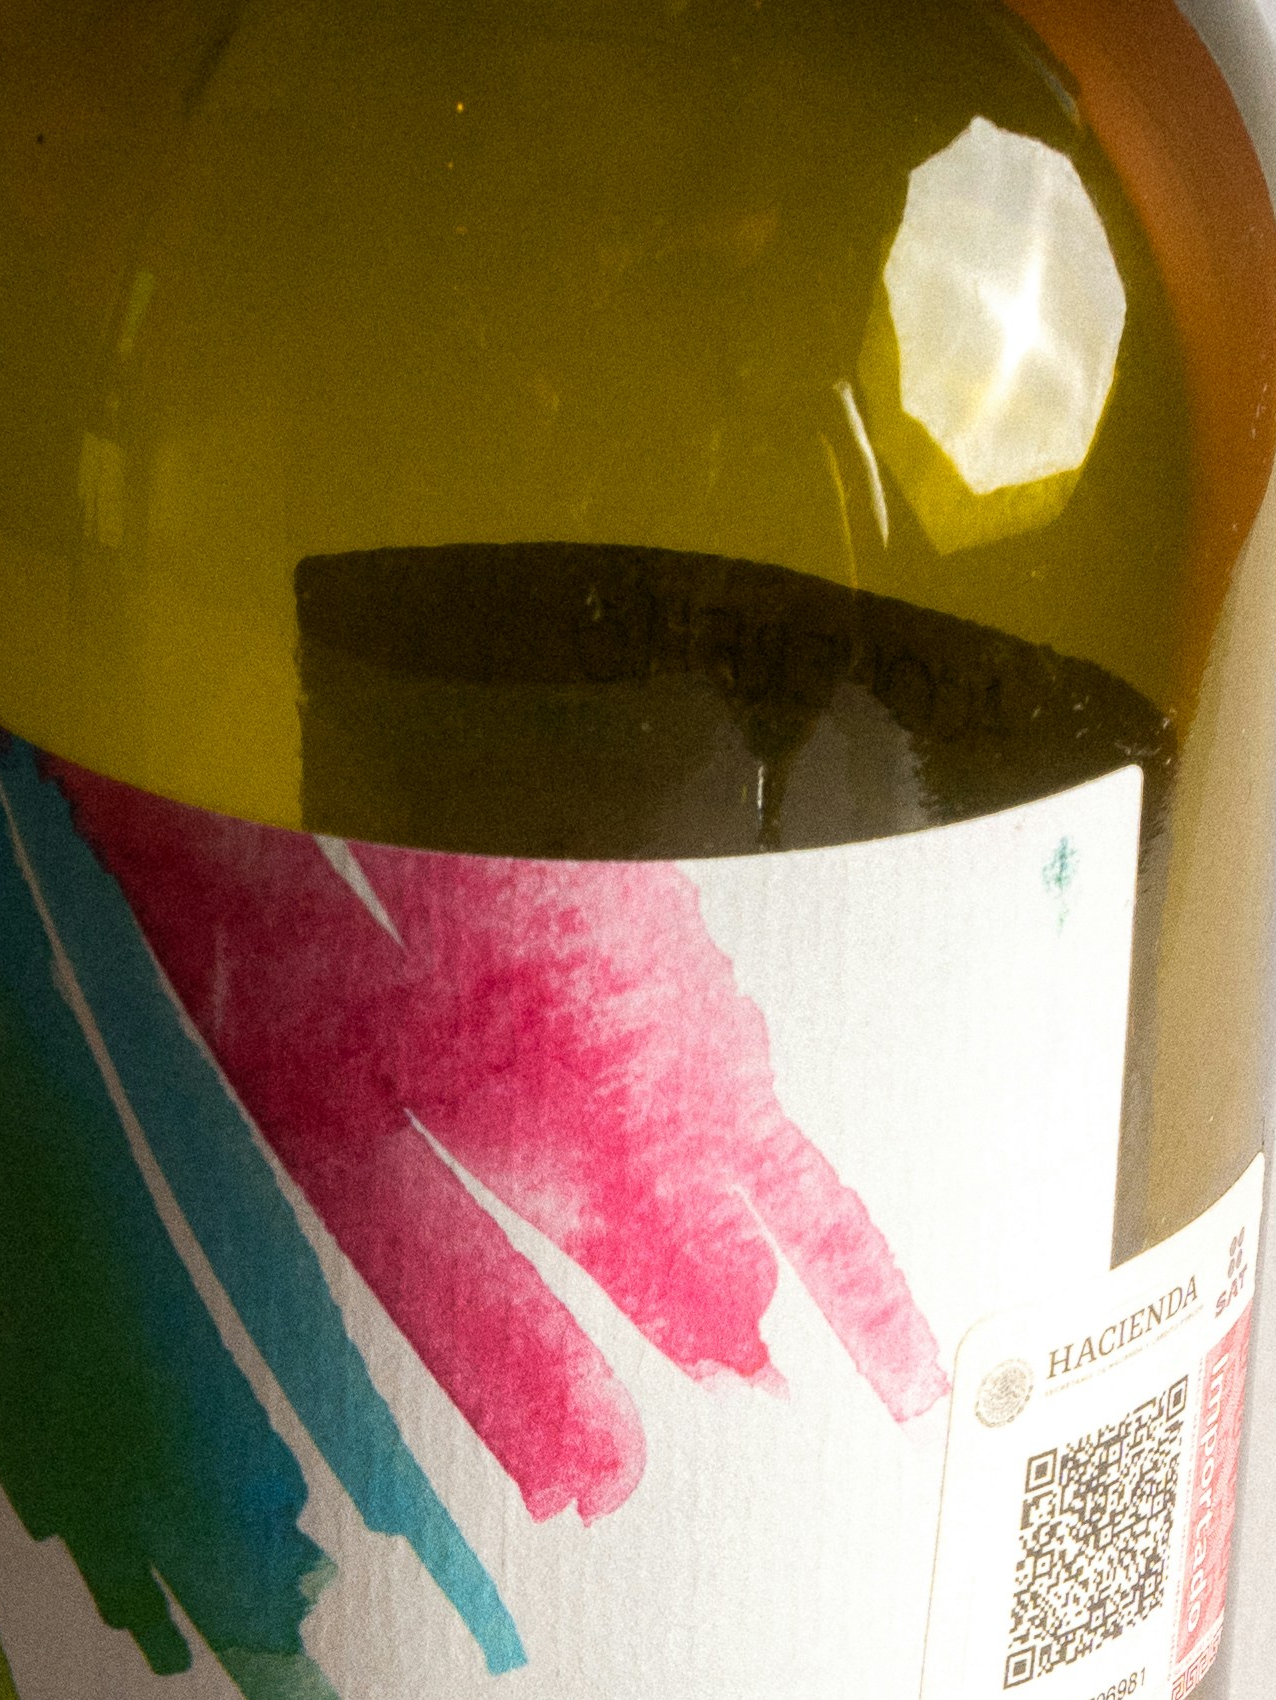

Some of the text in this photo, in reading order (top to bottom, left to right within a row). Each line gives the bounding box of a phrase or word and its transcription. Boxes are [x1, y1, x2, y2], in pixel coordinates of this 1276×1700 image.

[1046, 1274, 1199, 1380] HACIENDA
[1216, 1263, 1249, 1318] SAT
[1187, 1353, 1229, 1634] Importado
